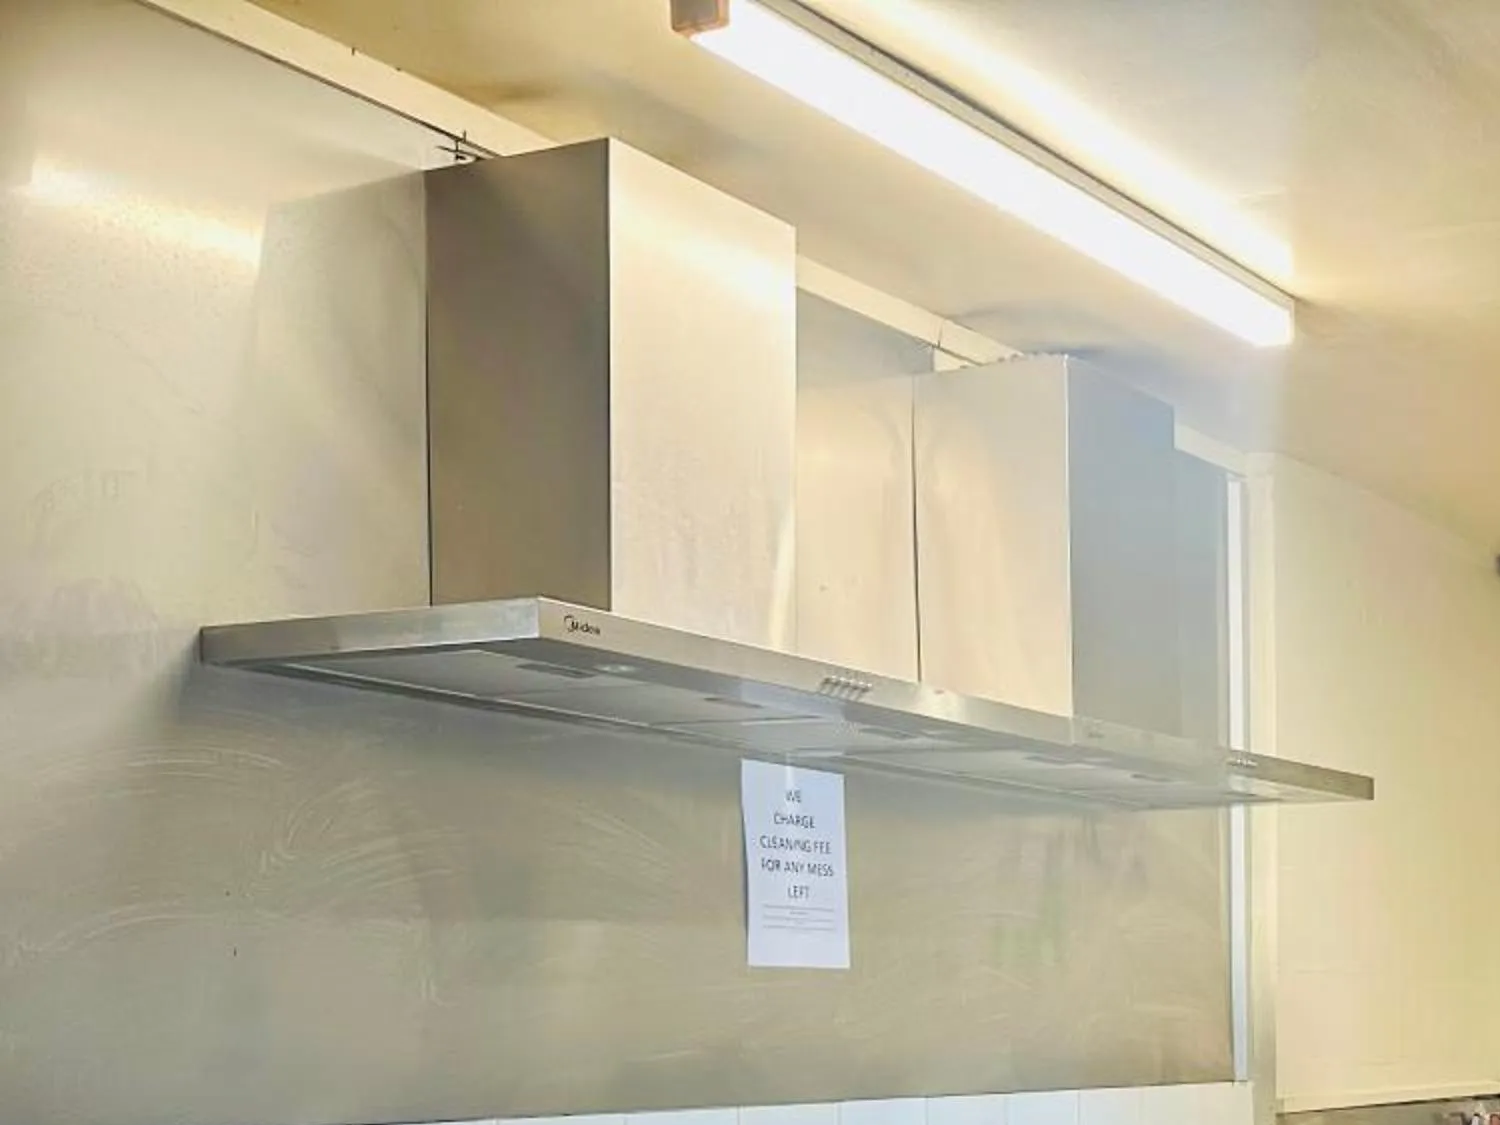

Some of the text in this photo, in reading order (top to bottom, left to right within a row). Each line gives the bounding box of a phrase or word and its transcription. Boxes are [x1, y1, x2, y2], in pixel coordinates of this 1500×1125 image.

[773, 812, 816, 829] CHARGE
[759, 835, 832, 854] CLEANING FEE
[761, 857, 835, 877] FOR ANY MESS
[787, 885, 810, 899] LEFT
